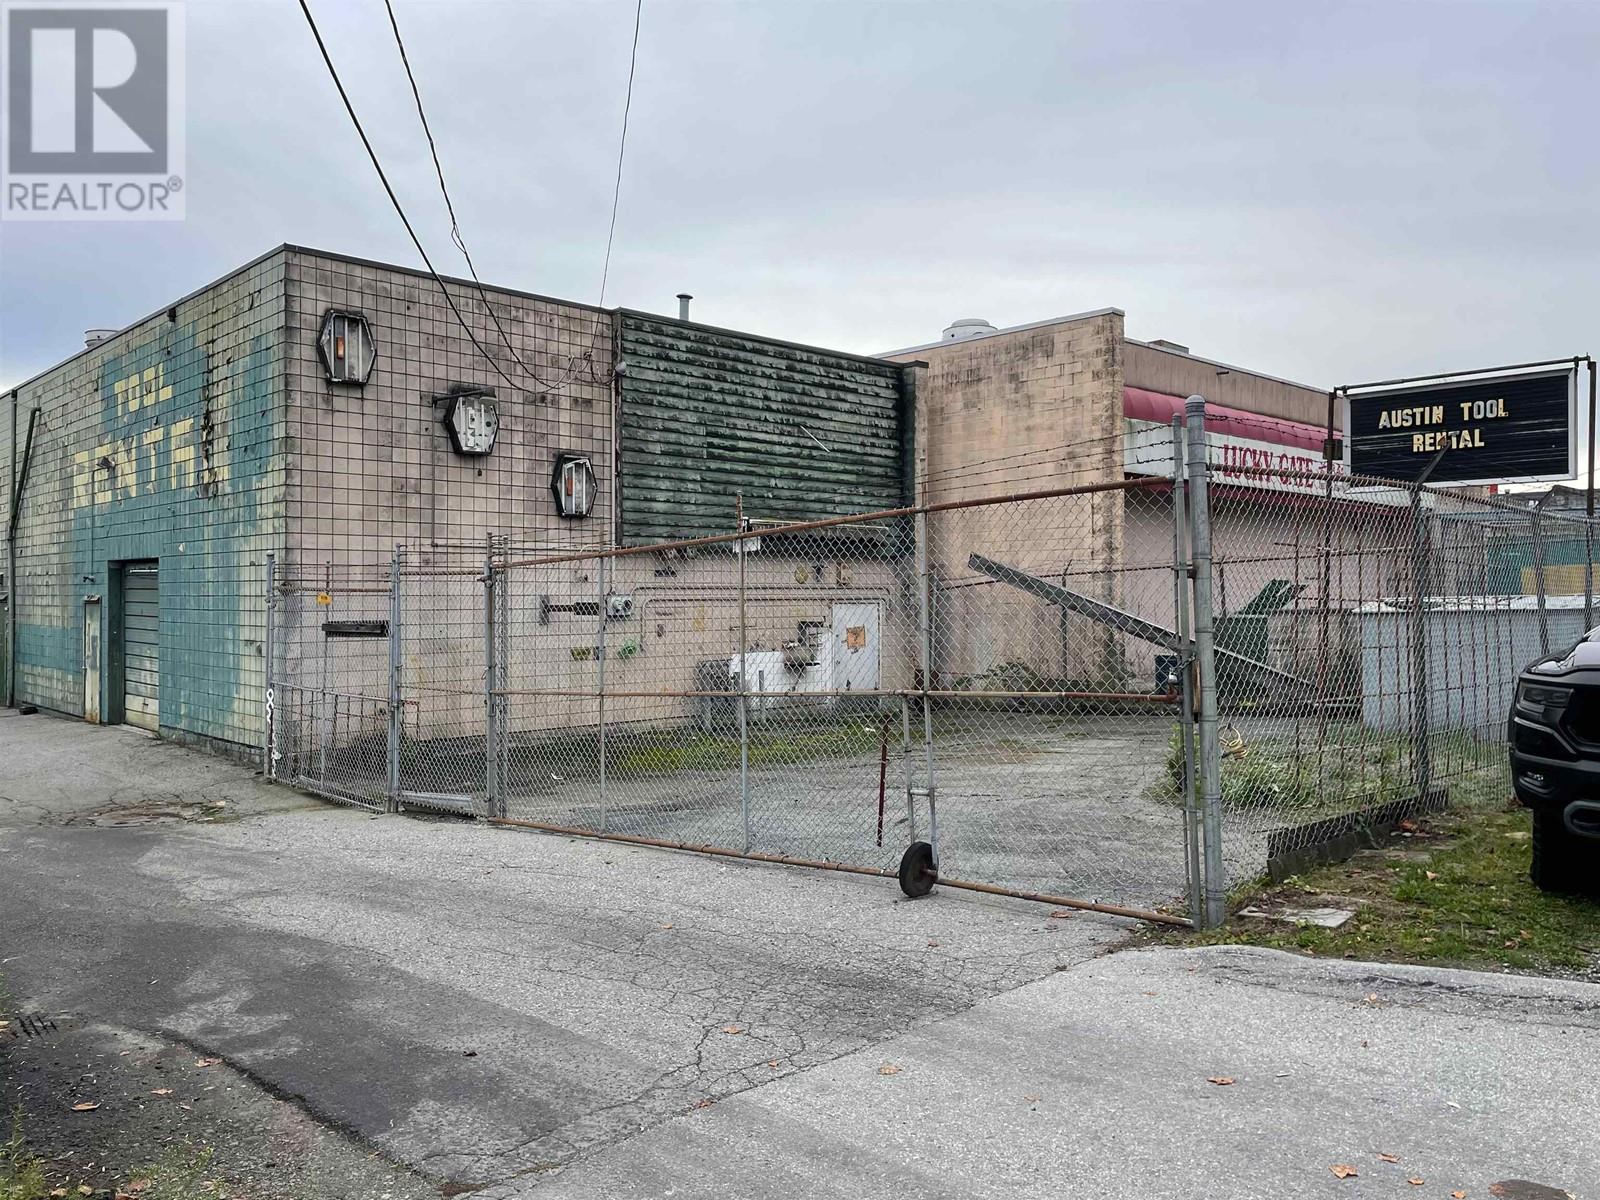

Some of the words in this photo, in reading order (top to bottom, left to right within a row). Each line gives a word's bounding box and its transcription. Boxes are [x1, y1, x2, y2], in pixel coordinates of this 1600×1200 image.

[114, 362, 173, 412] TOOL
[1378, 405, 1444, 429] AUSTIN
[1460, 398, 1509, 421] TOOL
[1412, 428, 1485, 453] RENTAL
[1223, 444, 1274, 482] LUCKY
[1279, 453, 1314, 488] GATE
